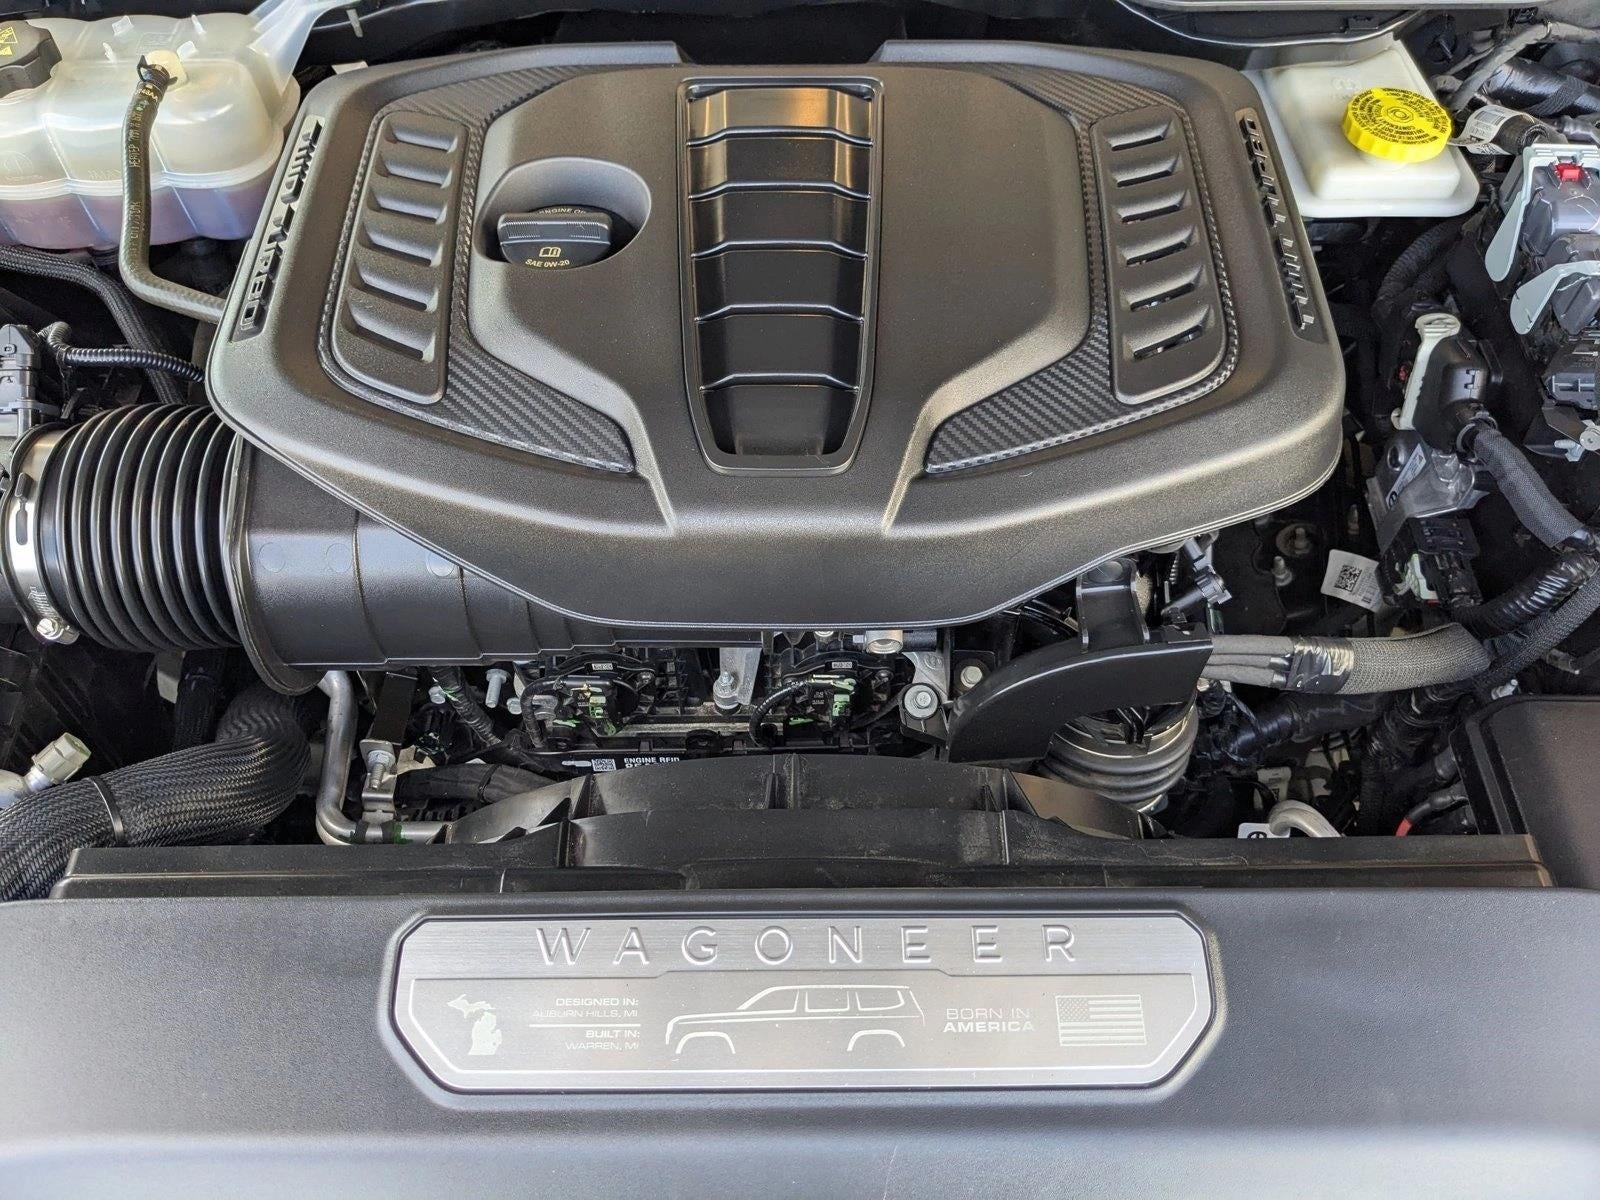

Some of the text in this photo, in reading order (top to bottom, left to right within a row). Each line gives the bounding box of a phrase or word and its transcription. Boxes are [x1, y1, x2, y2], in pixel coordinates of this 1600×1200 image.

[240, 203, 296, 330] TURBO
[525, 259, 570, 268] SAE 0W-20
[623, 756, 657, 764] ENGINE
[536, 924, 1077, 966] WAGONEER
[555, 997, 639, 1007] DESIGNED IN:
[532, 1008, 639, 1018] AUBURN HILLS, MI
[946, 1007, 1030, 1020] BORN IN
[943, 1021, 1034, 1033] AMERICA
[585, 1030, 640, 1039] BUILT IN:
[564, 1041, 622, 1051] WARREN,
